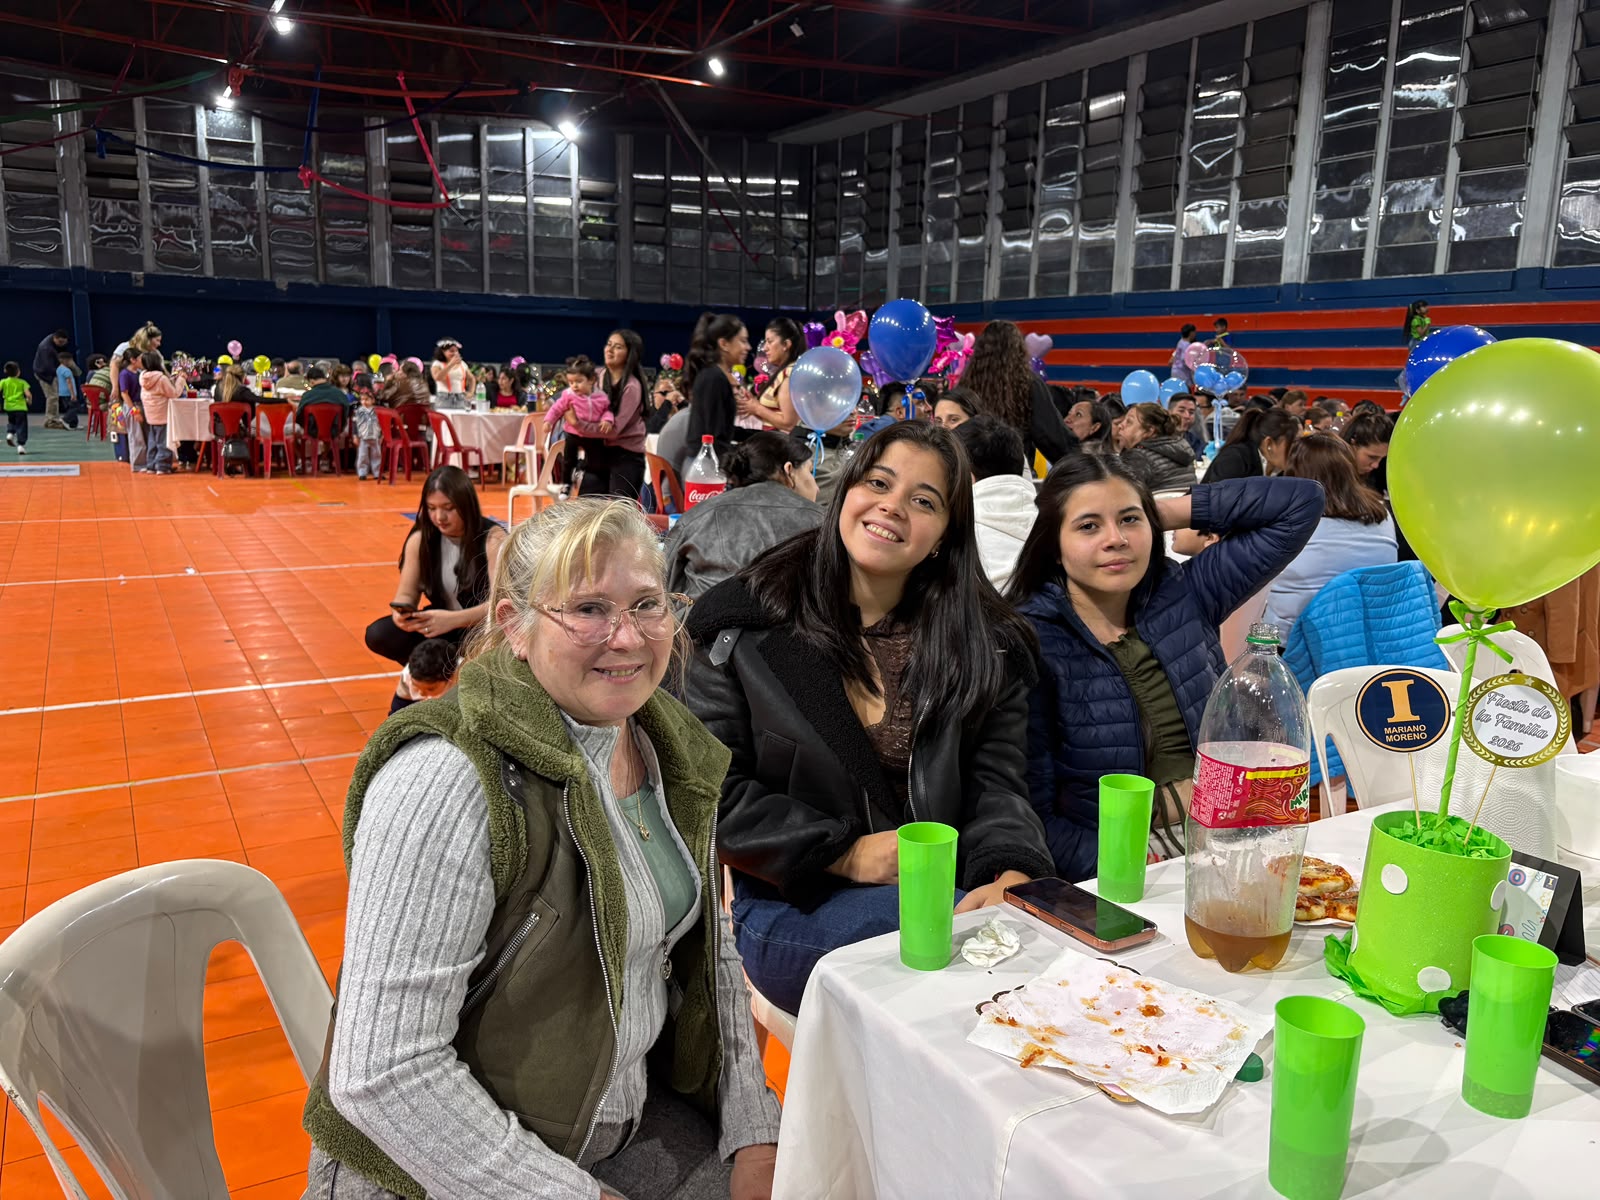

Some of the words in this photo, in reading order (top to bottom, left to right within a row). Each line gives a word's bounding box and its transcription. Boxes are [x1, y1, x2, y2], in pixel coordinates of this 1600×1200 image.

[1381, 680, 1420, 723] I
[1487, 691, 1530, 714] Fiesta
[1531, 705, 1552, 720] de
[1384, 724, 1427, 734] MARIANO
[1475, 709, 1492, 723] la
[1494, 713, 1549, 739] Familia
[1386, 732, 1427, 742] MORENO
[1488, 735, 1523, 752] 2026
[1290, 789, 1308, 810] MIR
